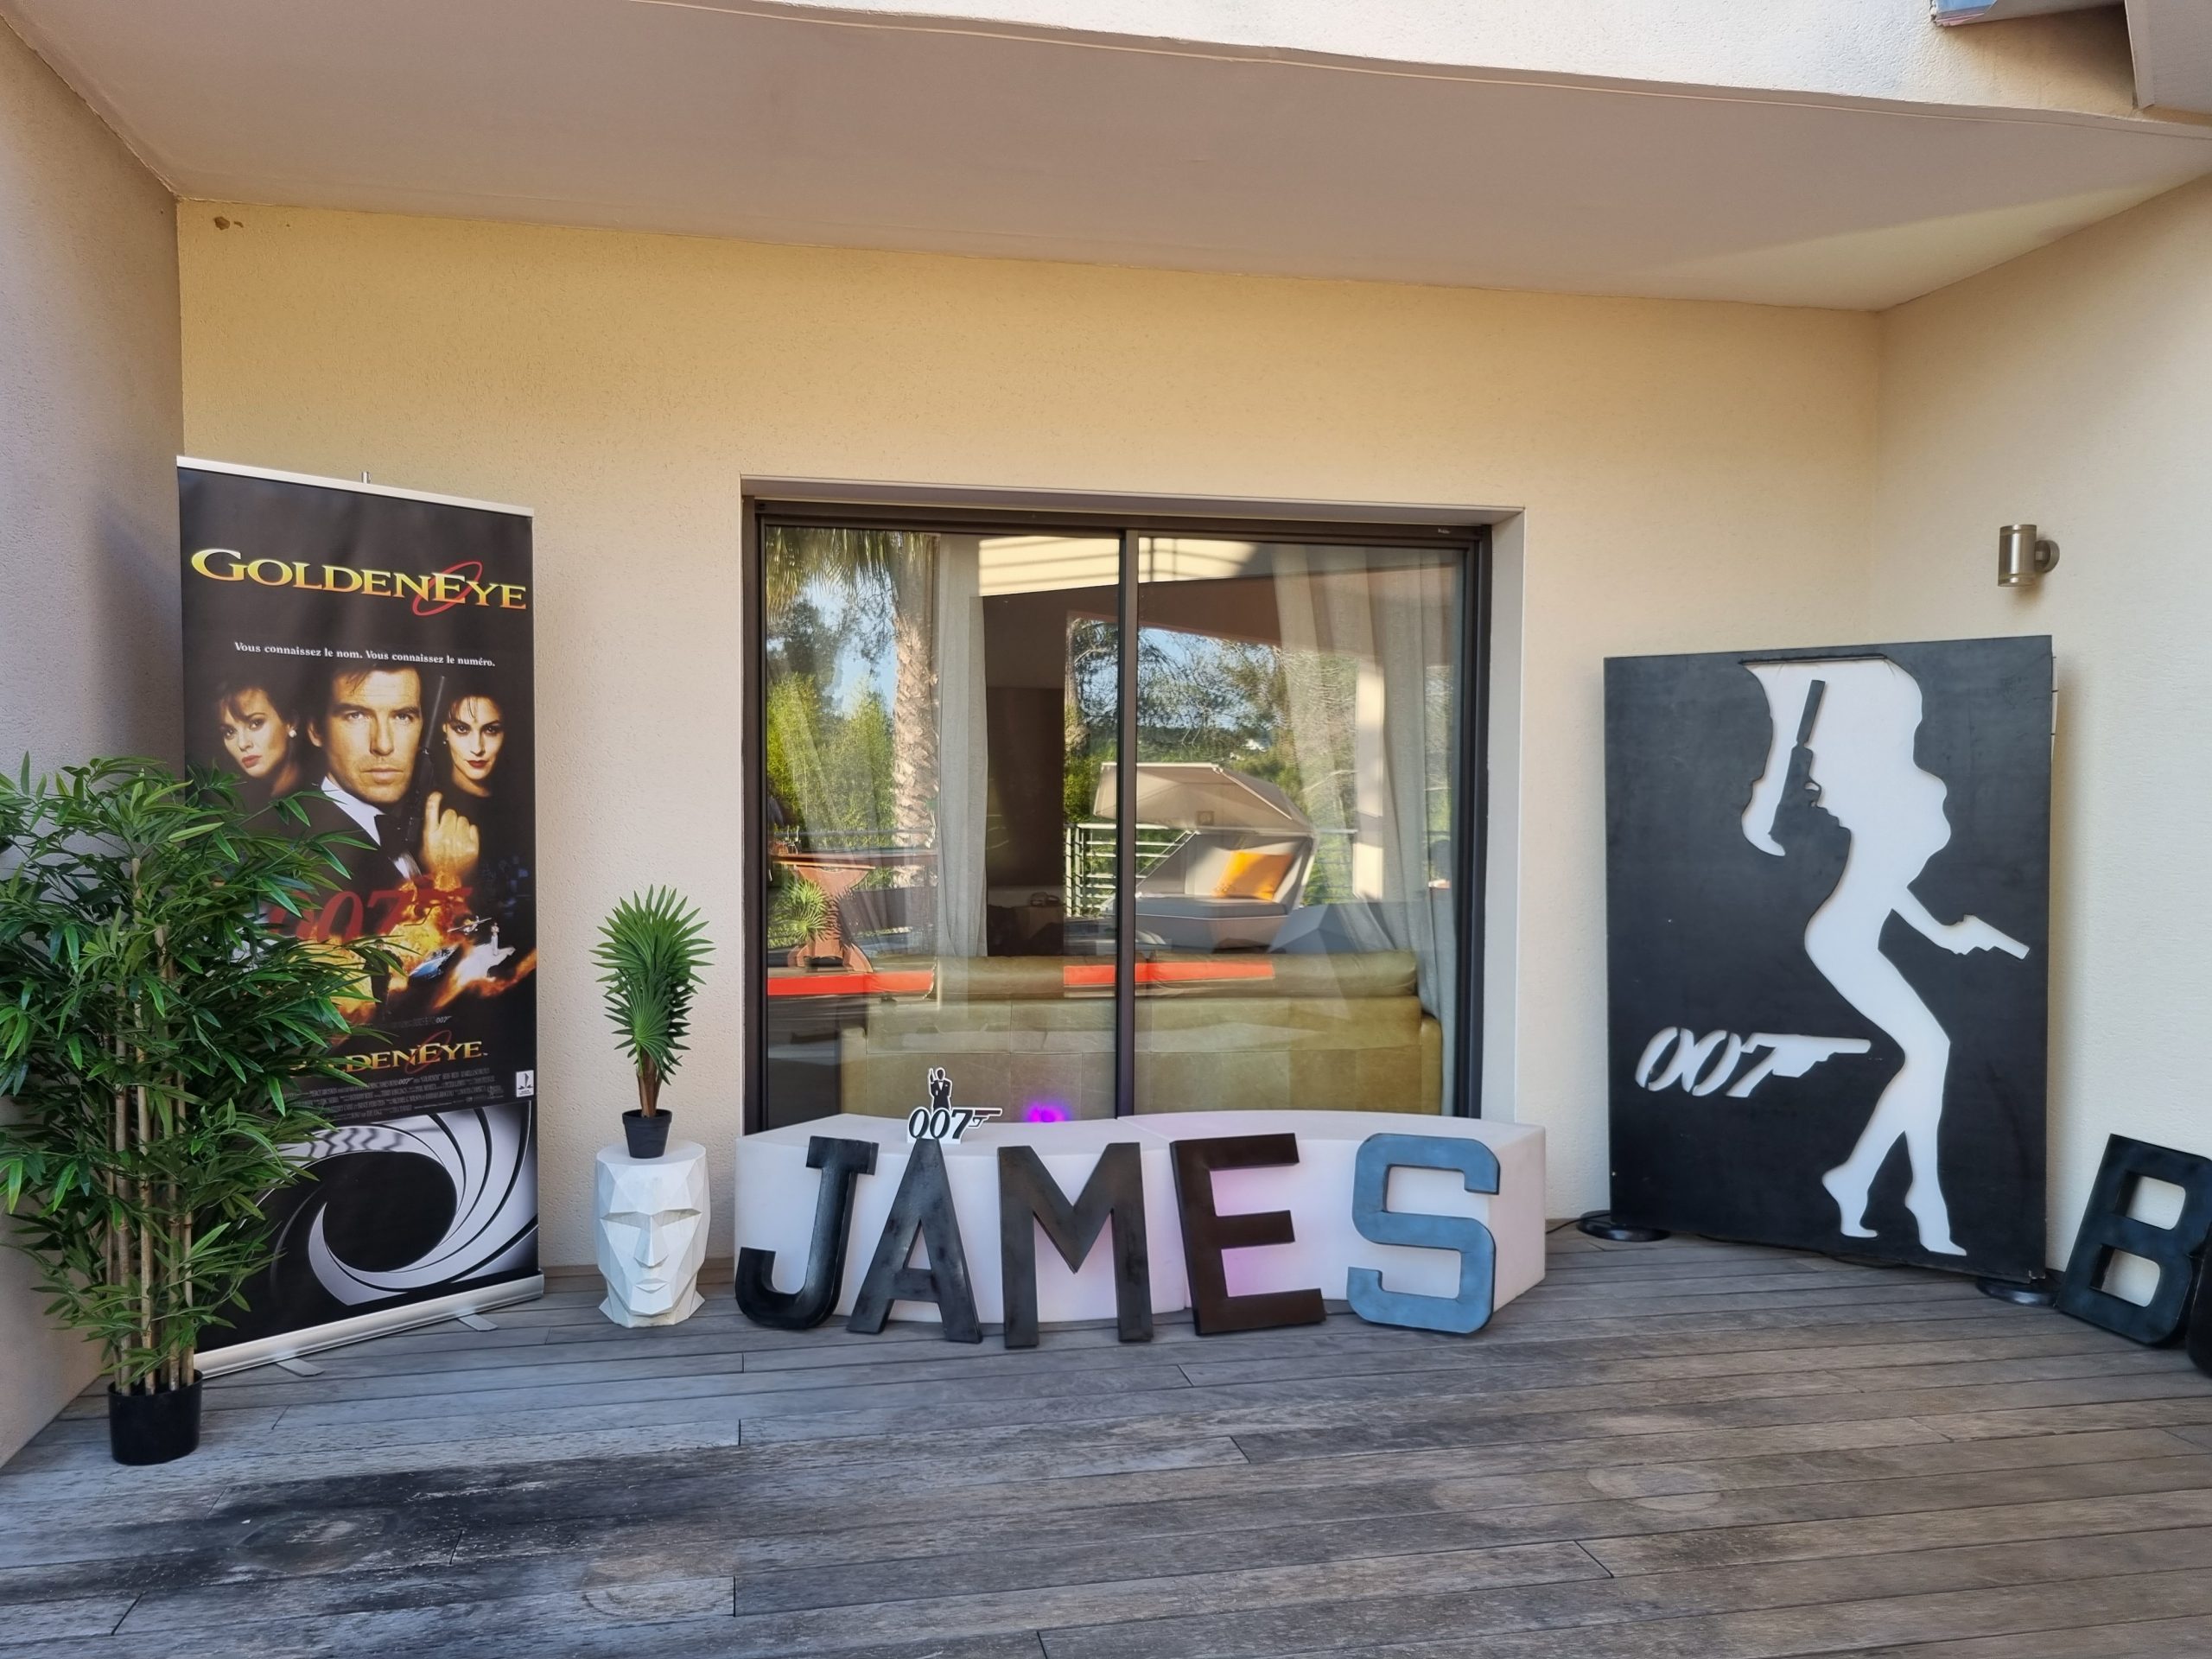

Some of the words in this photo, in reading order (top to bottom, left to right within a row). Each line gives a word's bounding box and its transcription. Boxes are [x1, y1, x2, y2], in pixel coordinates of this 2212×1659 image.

[191, 548, 527, 610] GOLDENEYE
[234, 642, 261, 652] Vous
[264, 645, 321, 657] connaissez
[324, 647, 334, 657] le
[336, 650, 363, 658] nom.
[365, 650, 389, 660] Vous
[391, 653, 444, 664] connaissez
[447, 655, 455, 664] le
[457, 657, 496, 667] numéro.
[268, 890, 418, 944] 007
[330, 1040, 483, 1073] DENEYE
[1635, 1026, 1783, 1097] 007
[908, 1108, 974, 1140] 007
[734, 1132, 1501, 1348] JAMES
[2055, 1133, 2212, 1349] B
